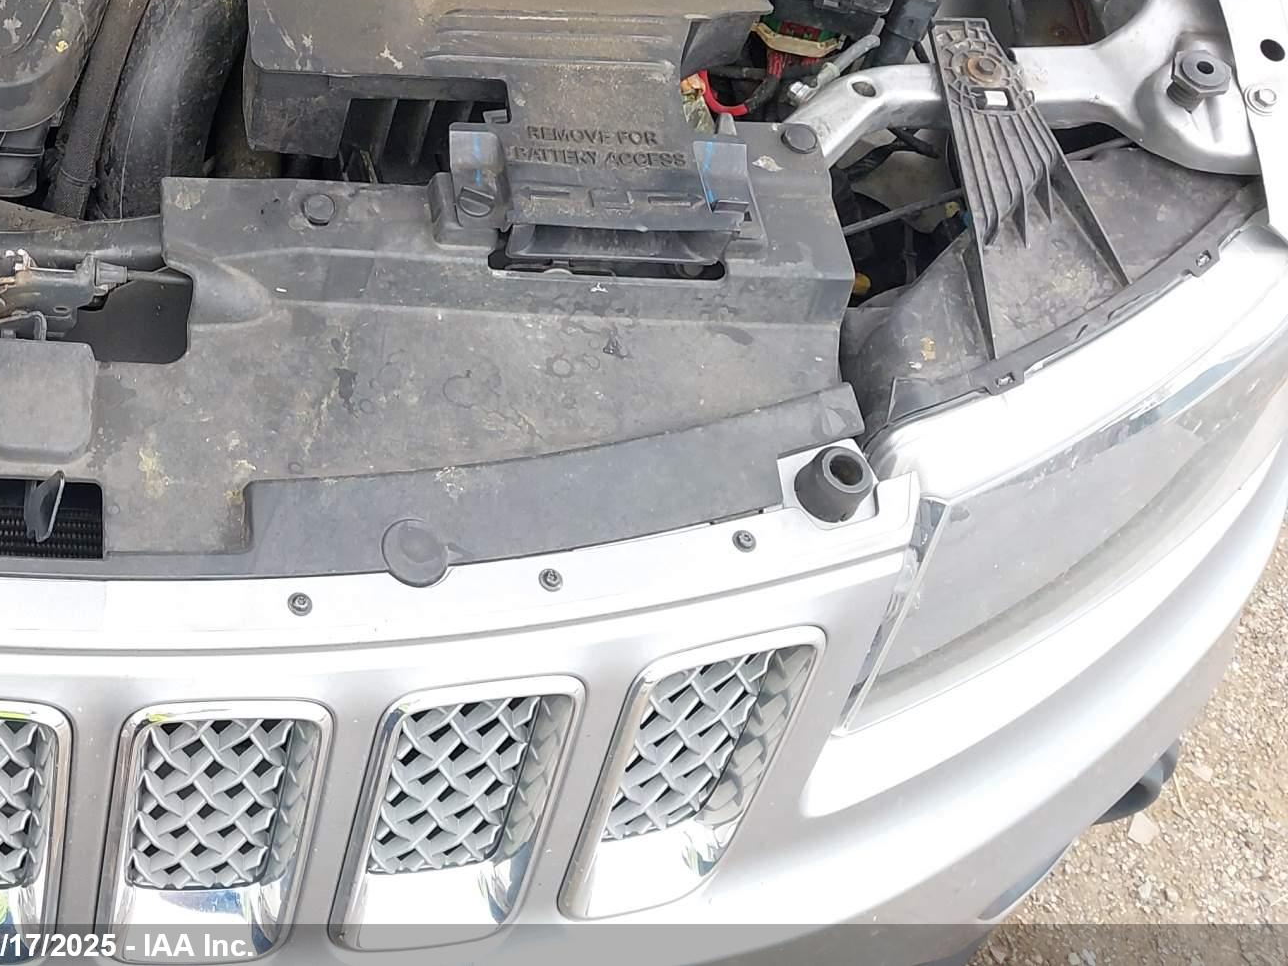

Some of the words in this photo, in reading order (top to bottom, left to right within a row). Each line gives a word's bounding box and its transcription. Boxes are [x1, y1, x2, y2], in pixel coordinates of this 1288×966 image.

[526, 124, 611, 145] REMOVE
[617, 129, 659, 146] FOR
[512, 145, 598, 166] BATTERY
[604, 150, 687, 168] ACCESS
